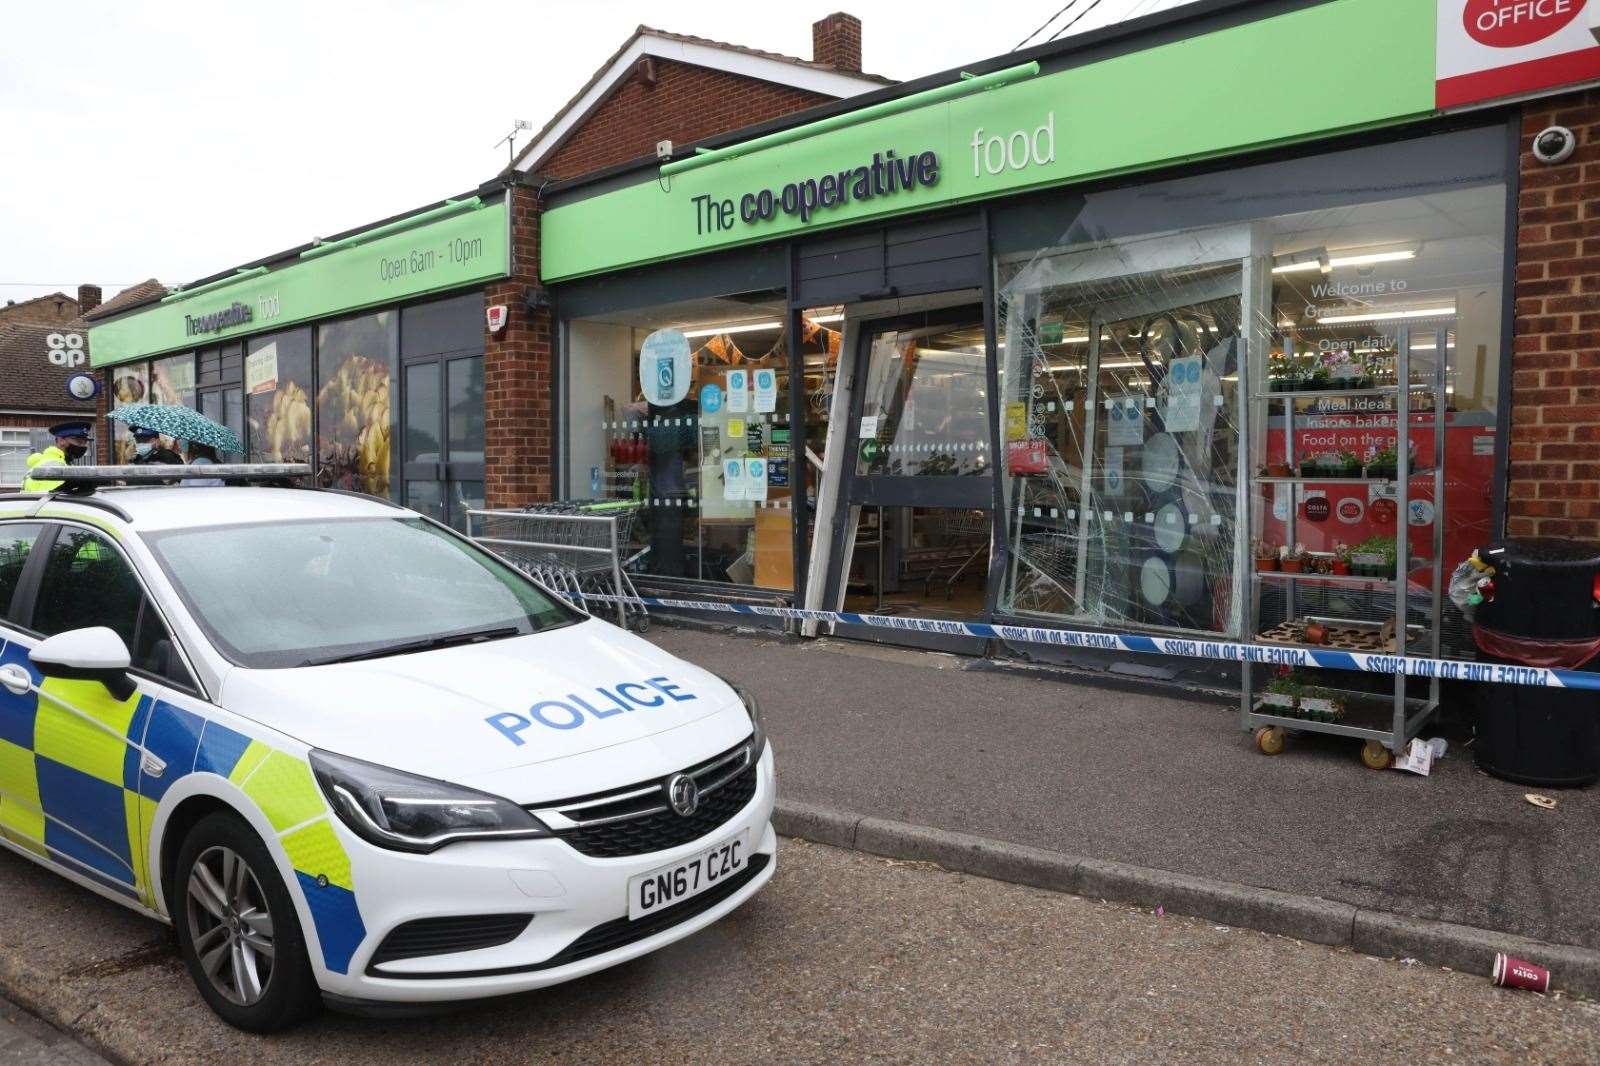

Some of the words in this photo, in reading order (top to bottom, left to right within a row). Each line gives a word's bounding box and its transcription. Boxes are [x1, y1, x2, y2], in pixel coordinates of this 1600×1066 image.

[1476, 0, 1571, 31] OFFICE
[691, 193, 736, 236] The
[970, 111, 1057, 178] food
[380, 257, 407, 284] Open
[410, 250, 435, 274] 6am
[447, 237, 483, 266] 10pm
[1311, 282, 1386, 299] Welcome
[1390, 279, 1408, 291] to
[184, 313, 198, 338] The
[257, 288, 280, 320] food
[1318, 338, 1357, 354] Open
[1361, 334, 1397, 351] daily
[1318, 399, 1351, 411] Meal
[1354, 398, 1392, 410] ideas
[1307, 416, 1352, 429] Instore
[1302, 434, 1336, 446] Food
[1339, 436, 1356, 446] on
[1361, 433, 1384, 446] the
[1306, 504, 1328, 512] COSTA
[1001, 626, 1029, 641] CROSS
[1031, 628, 1047, 642] NOT
[1050, 631, 1061, 644] DO
[1064, 632, 1084, 646] LINE
[1086, 634, 1118, 649] POLICE
[1164, 640, 1197, 656] CROSS
[1201, 642, 1220, 658] NOT
[1223, 645, 1237, 661] DO
[1240, 645, 1265, 663] LINE
[1268, 648, 1306, 666] POLICE
[1366, 655, 1407, 675] CROSS
[1412, 658, 1436, 677] NOT
[1440, 661, 1459, 679] DO
[1463, 663, 1493, 682] LINE
[1498, 665, 1548, 687] POLICE
[484, 676, 698, 747] POLICE
[640, 859, 702, 910] GN67
[707, 840, 741, 881] CZC
[1513, 968, 1539, 981] COSTA
